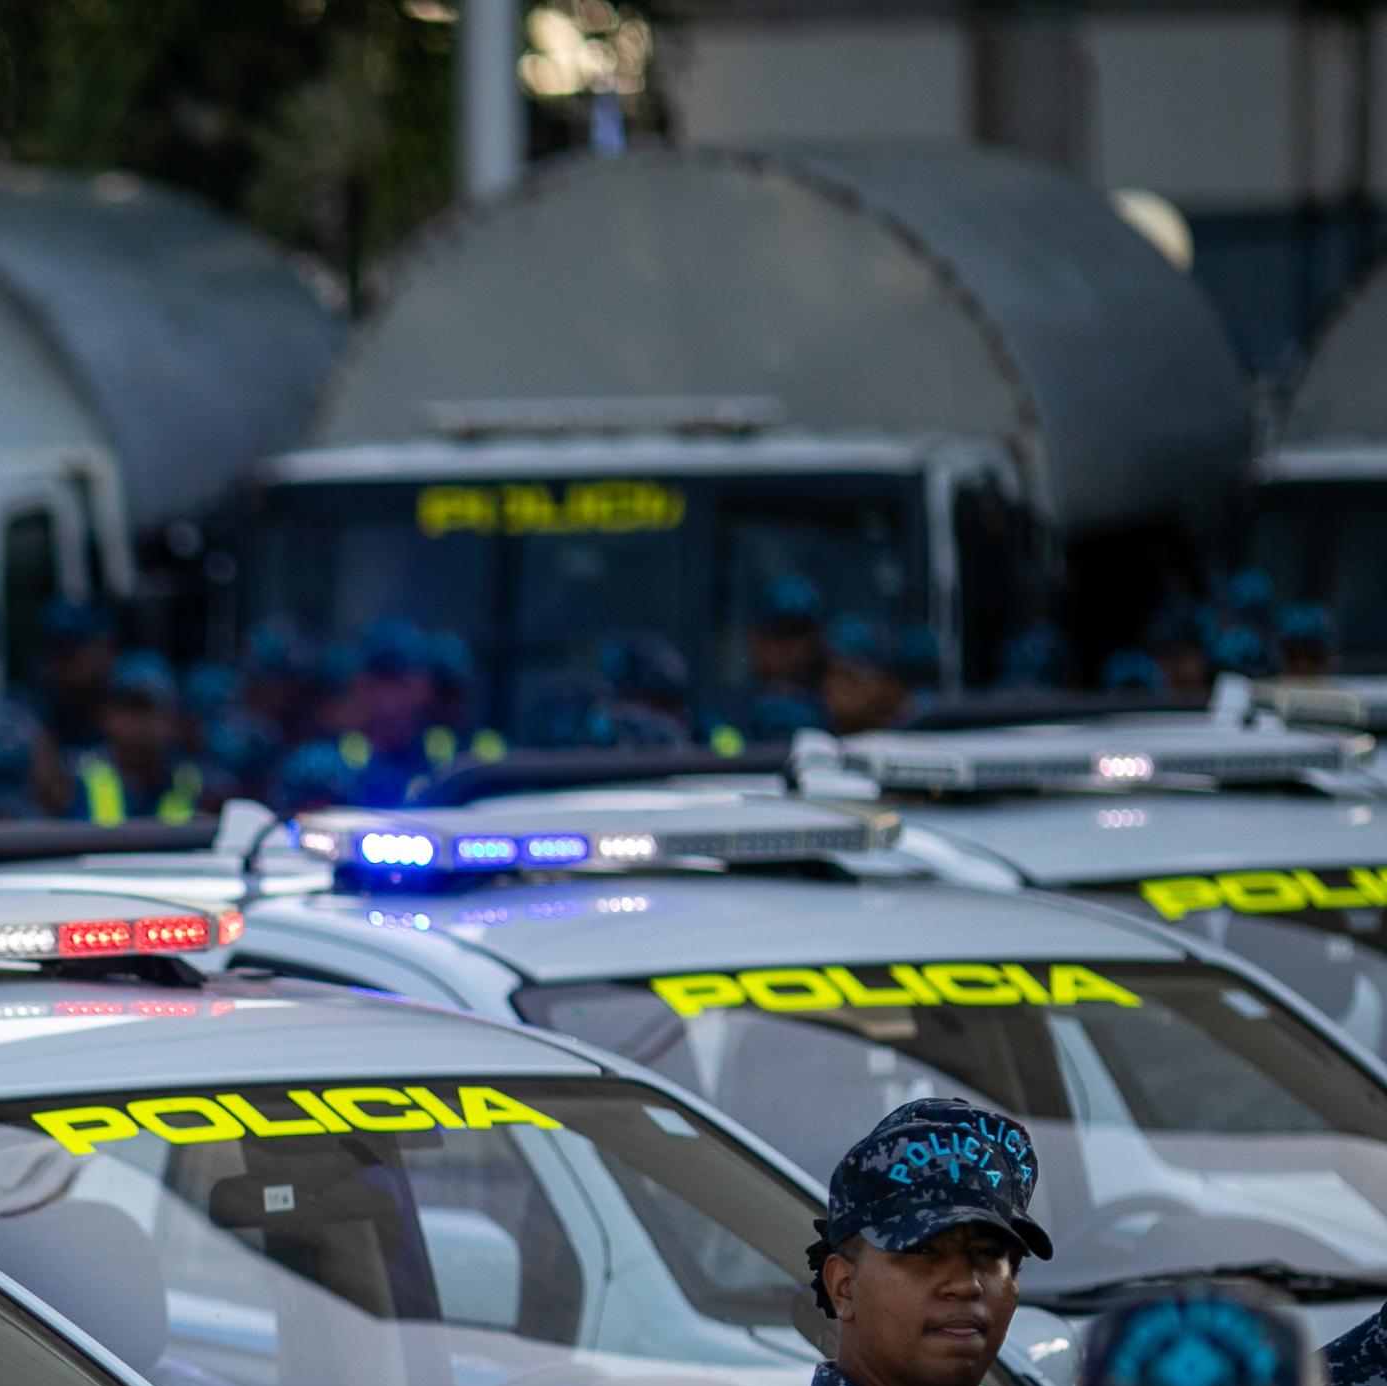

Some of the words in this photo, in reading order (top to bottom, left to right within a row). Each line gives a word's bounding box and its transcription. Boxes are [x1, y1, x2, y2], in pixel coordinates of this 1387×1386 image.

[1140, 866, 1387, 921] POLI
[650, 963, 1142, 1018] POLICIA
[30, 1085, 563, 1157] POLICIA
[957, 1117, 1033, 1182] LICIA
[888, 1132, 1003, 1189] POLICIA
